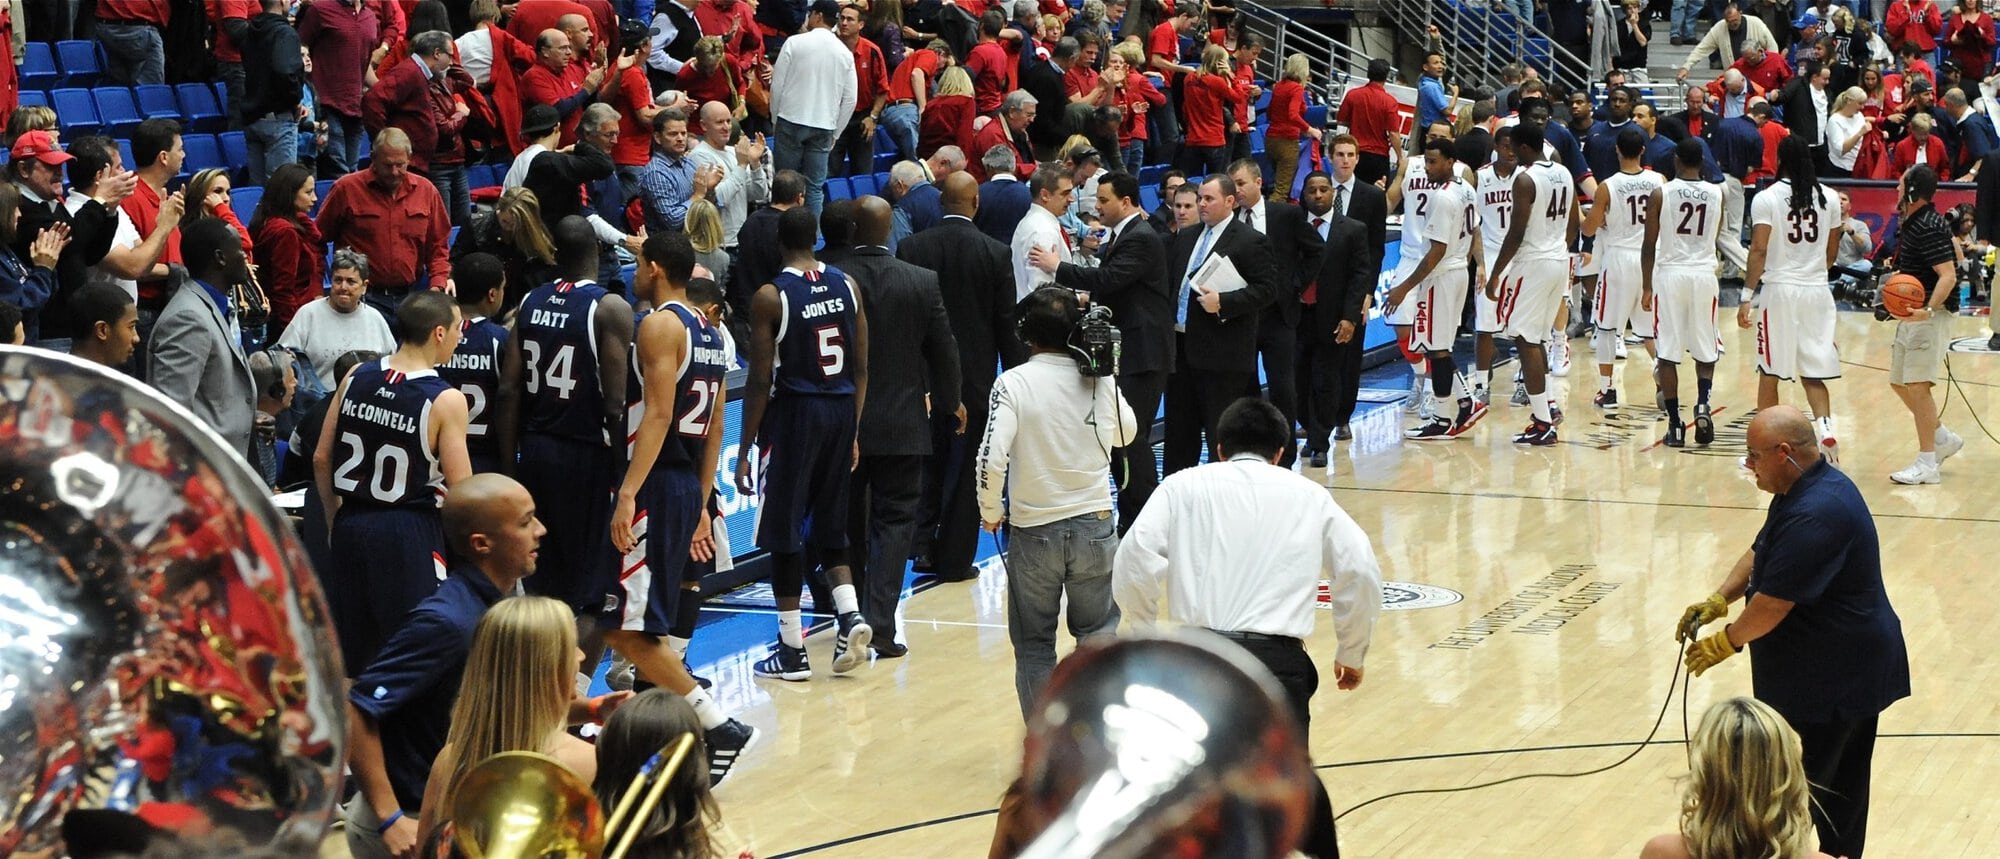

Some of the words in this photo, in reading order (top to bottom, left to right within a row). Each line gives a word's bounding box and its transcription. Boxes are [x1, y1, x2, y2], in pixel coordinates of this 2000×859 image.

[1416, 193, 1428, 216] 2
[1546, 186, 1567, 221] 44
[1627, 194, 1650, 226] 13
[1678, 188, 1709, 201] FOGG
[1676, 201, 1707, 236] 21
[1787, 209, 1819, 244] 33
[530, 309, 570, 328] DATT
[802, 298, 845, 319] JONES
[1416, 301, 1427, 333] CATS
[817, 326, 844, 376] 5
[523, 339, 577, 399] 34
[341, 398, 417, 434] McCONNELL
[678, 379, 720, 437] 21
[980, 390, 1000, 490] HOLLISTER
[333, 431, 409, 503] 20
[1523, 564, 1598, 592] ARIZONA
[1452, 598, 1541, 635] UNIVERSITY
[1511, 605, 1589, 636] MEDICAL
[1558, 581, 1625, 605] CENTER
[1427, 635, 1485, 650] THE
